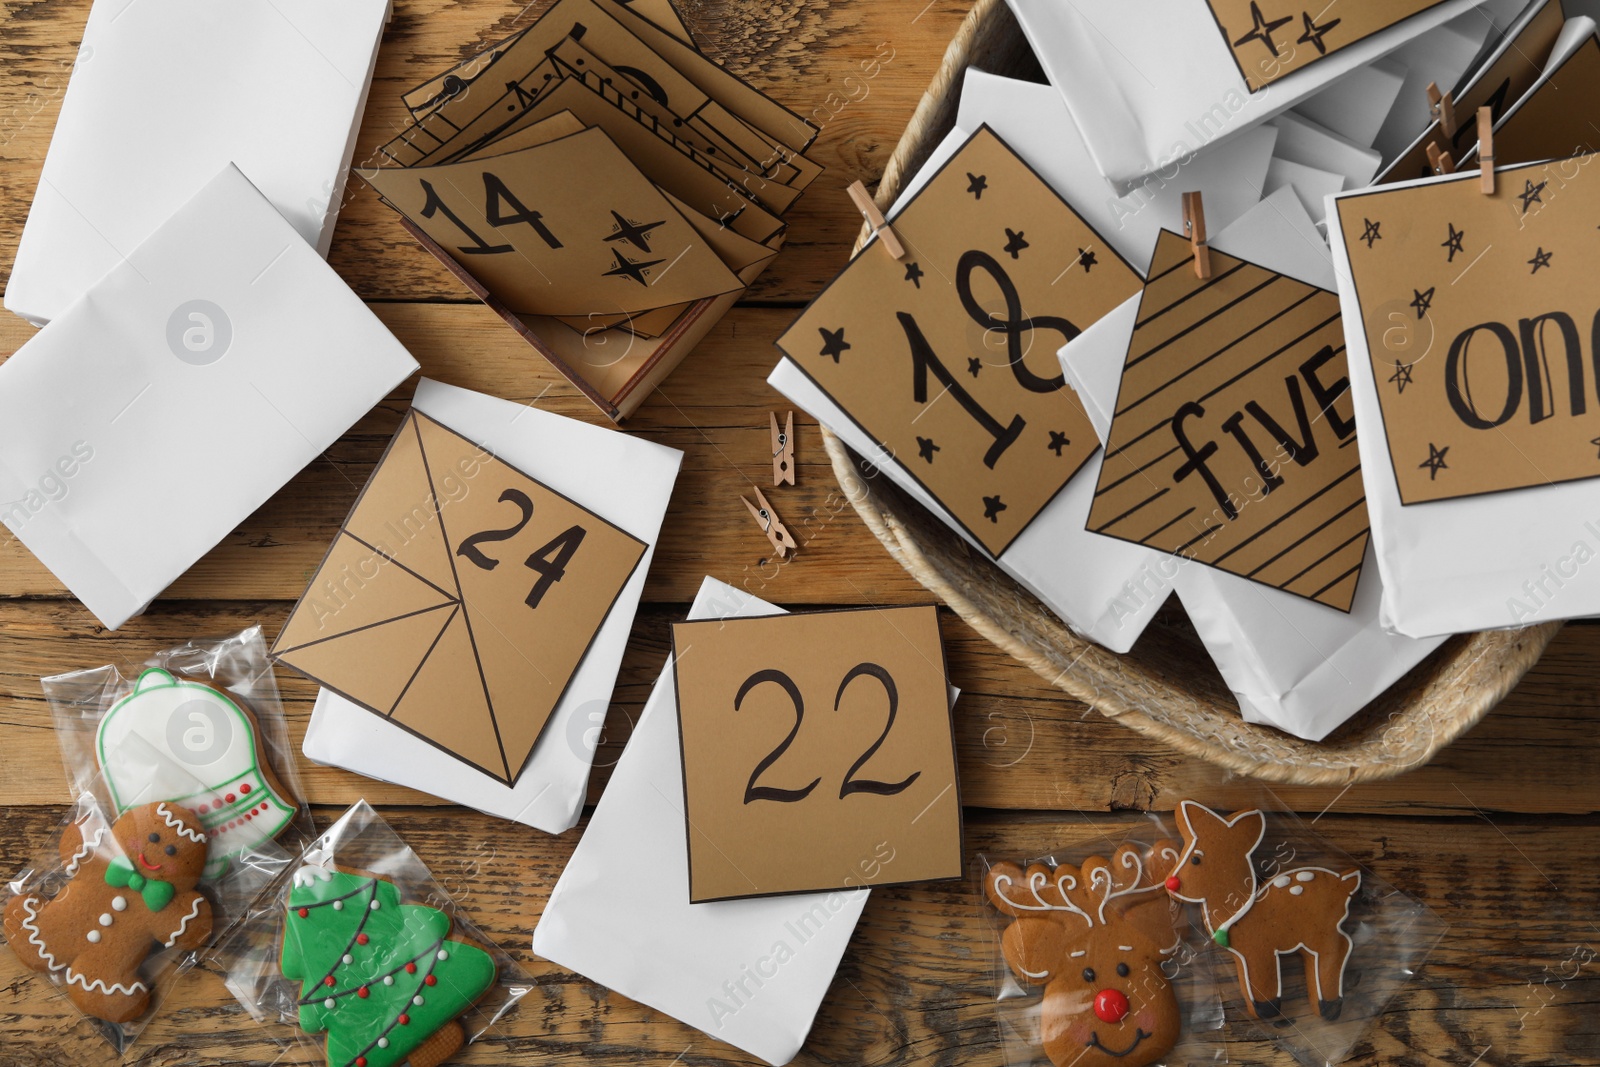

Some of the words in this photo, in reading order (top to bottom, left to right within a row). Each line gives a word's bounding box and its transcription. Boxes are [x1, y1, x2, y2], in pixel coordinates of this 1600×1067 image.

[420, 172, 564, 255] 14
[896, 250, 1083, 470] 18
[1445, 311, 1600, 430] on
[456, 488, 587, 609] 24
[734, 662, 921, 805] 22
